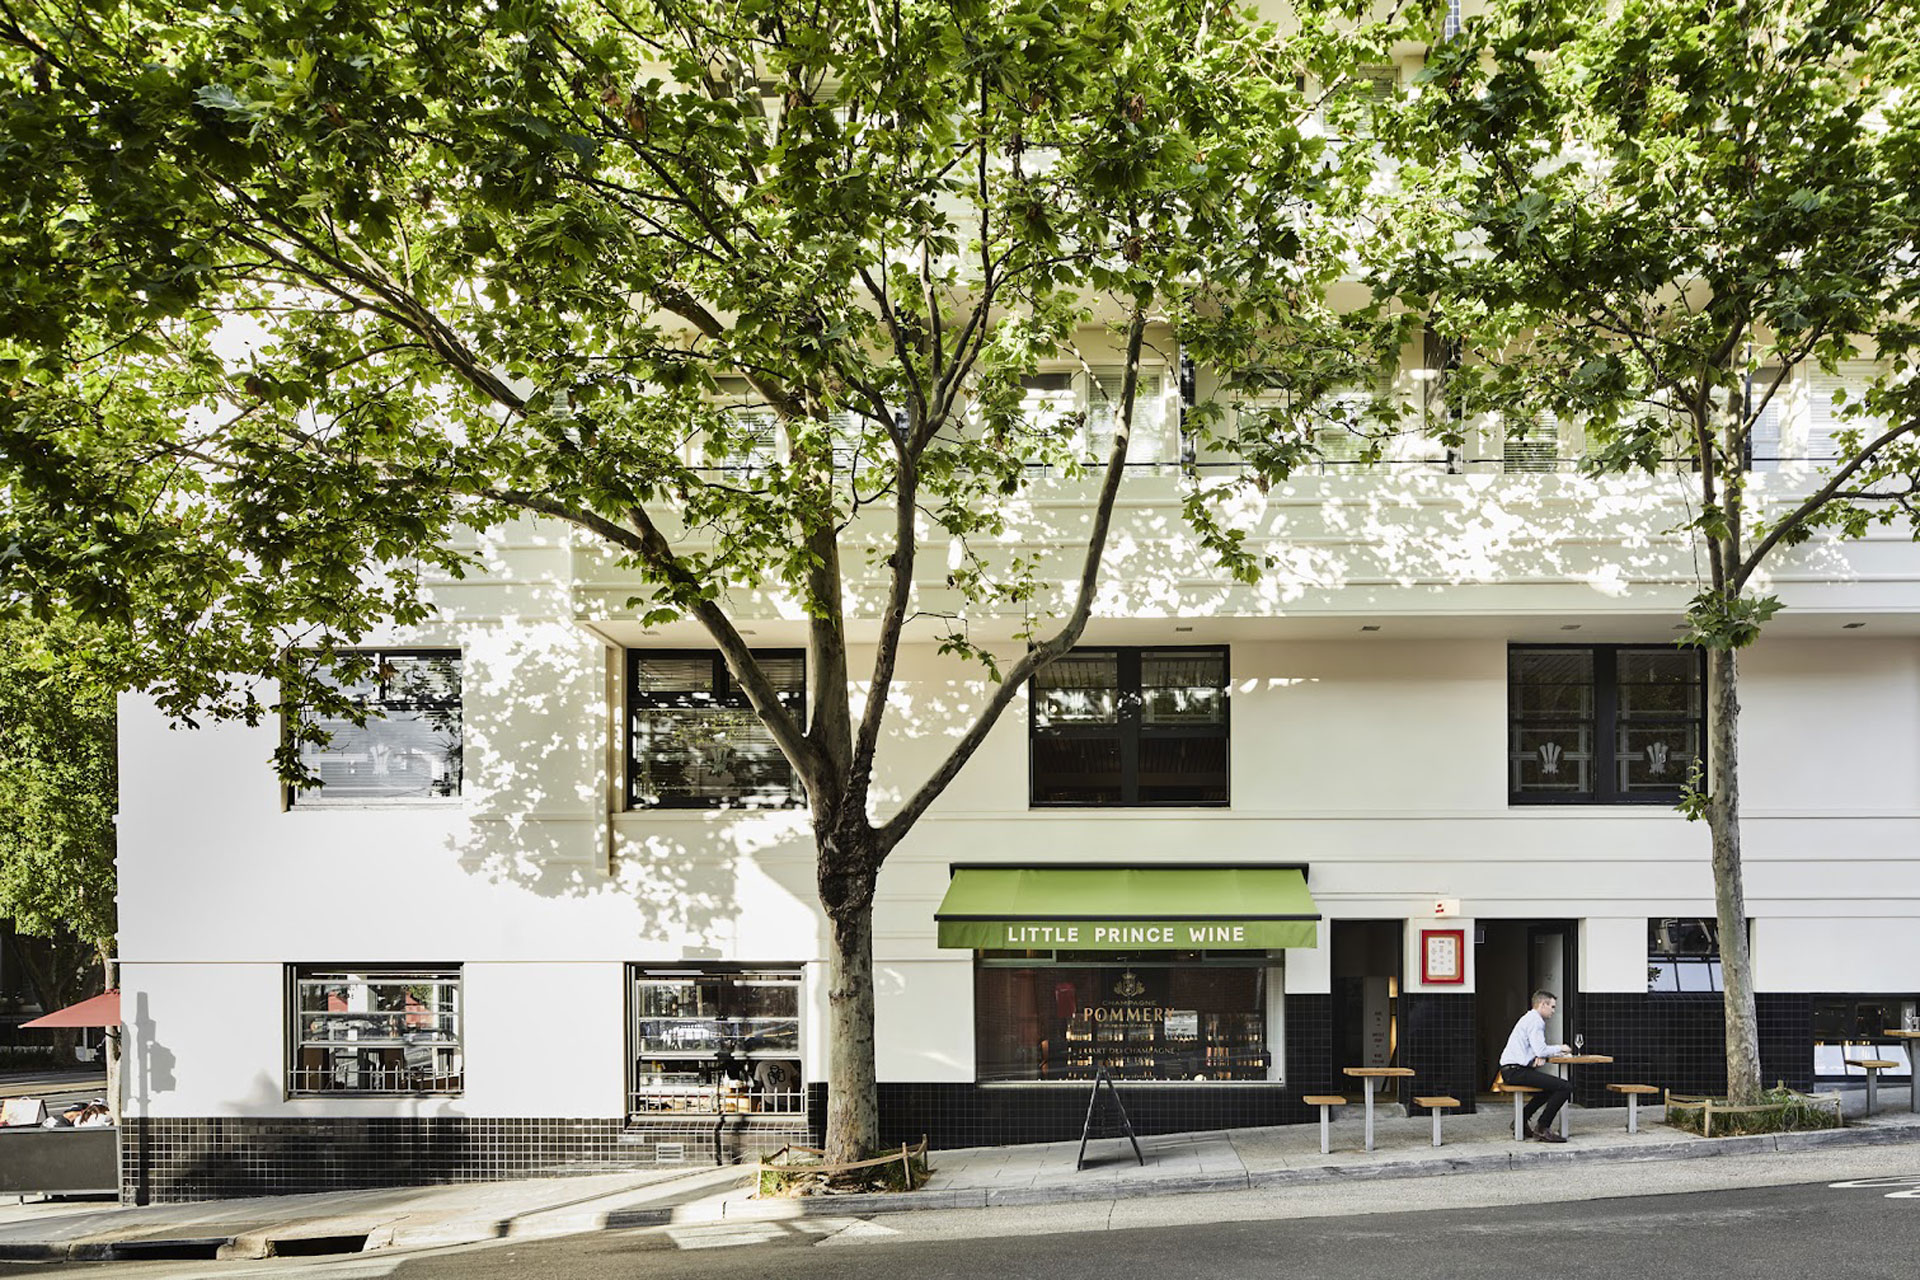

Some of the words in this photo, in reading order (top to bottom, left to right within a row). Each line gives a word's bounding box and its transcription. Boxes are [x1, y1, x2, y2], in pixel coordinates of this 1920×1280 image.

[1008, 927, 1079, 943] LITTLE
[1095, 927, 1174, 943] PRINCE
[1189, 927, 1244, 942] WINE
[1083, 1007, 1175, 1022] POMMERY
